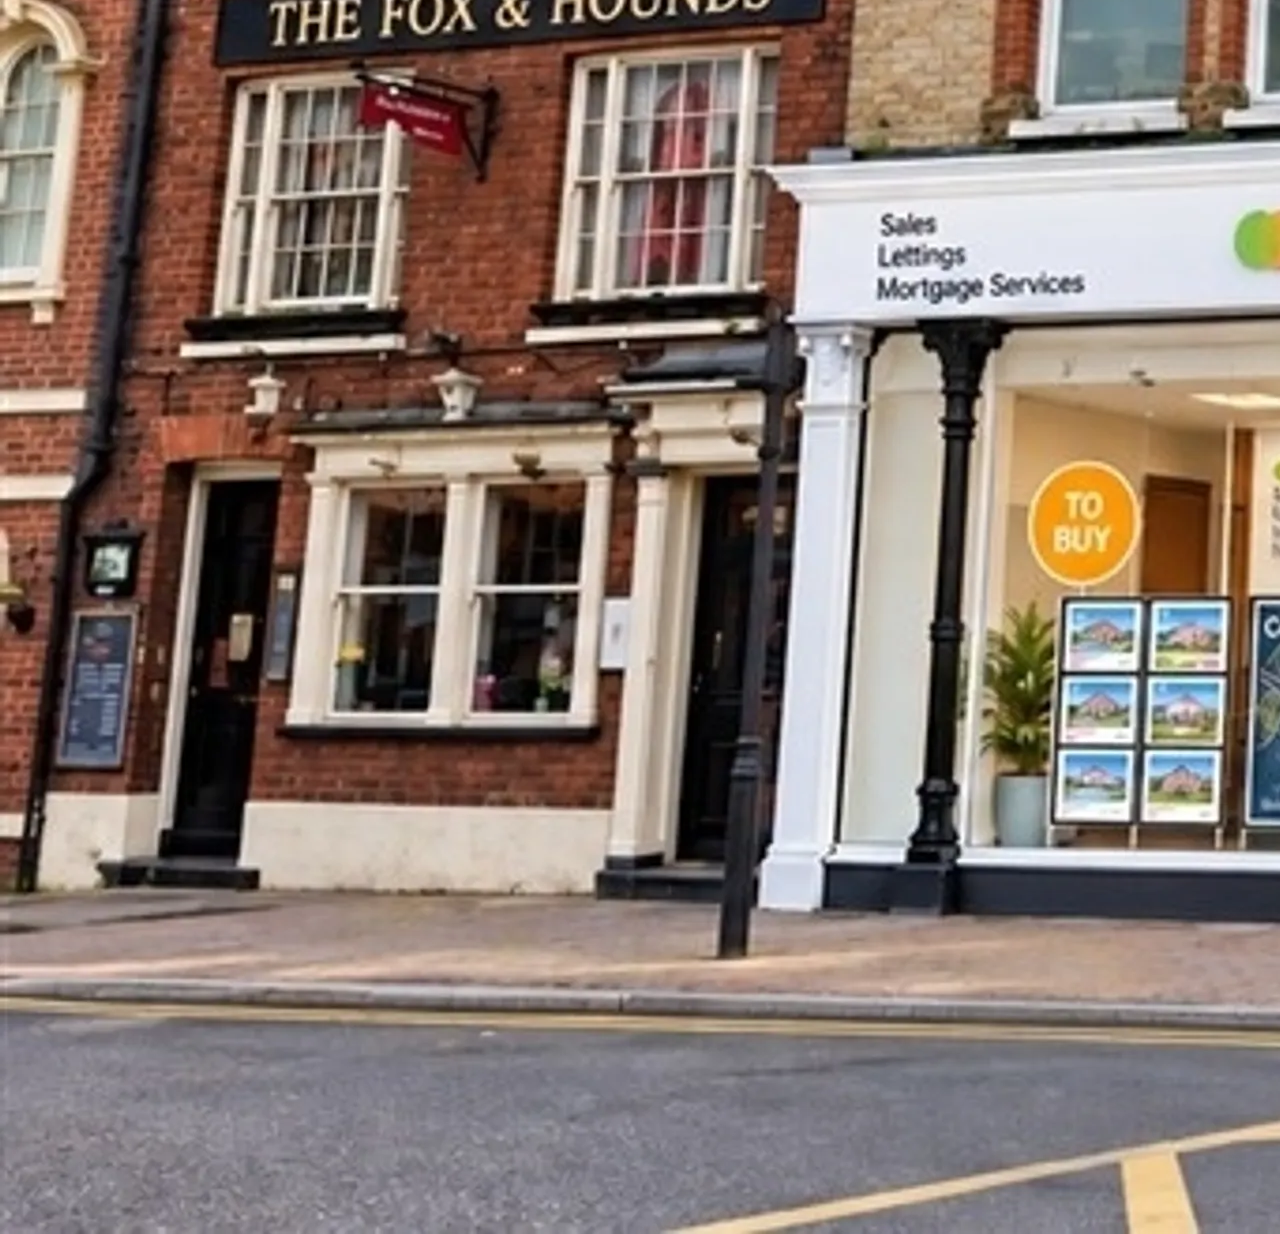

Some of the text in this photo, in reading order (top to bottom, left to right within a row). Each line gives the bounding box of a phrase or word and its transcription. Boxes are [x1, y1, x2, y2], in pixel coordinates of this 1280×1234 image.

[880, 213, 937, 237] Sales
[877, 243, 967, 271] Lettings
[876, 271, 1085, 305] Mortgage Services
[1063, 490, 1104, 521] TO
[1053, 524, 1112, 554] BUY
